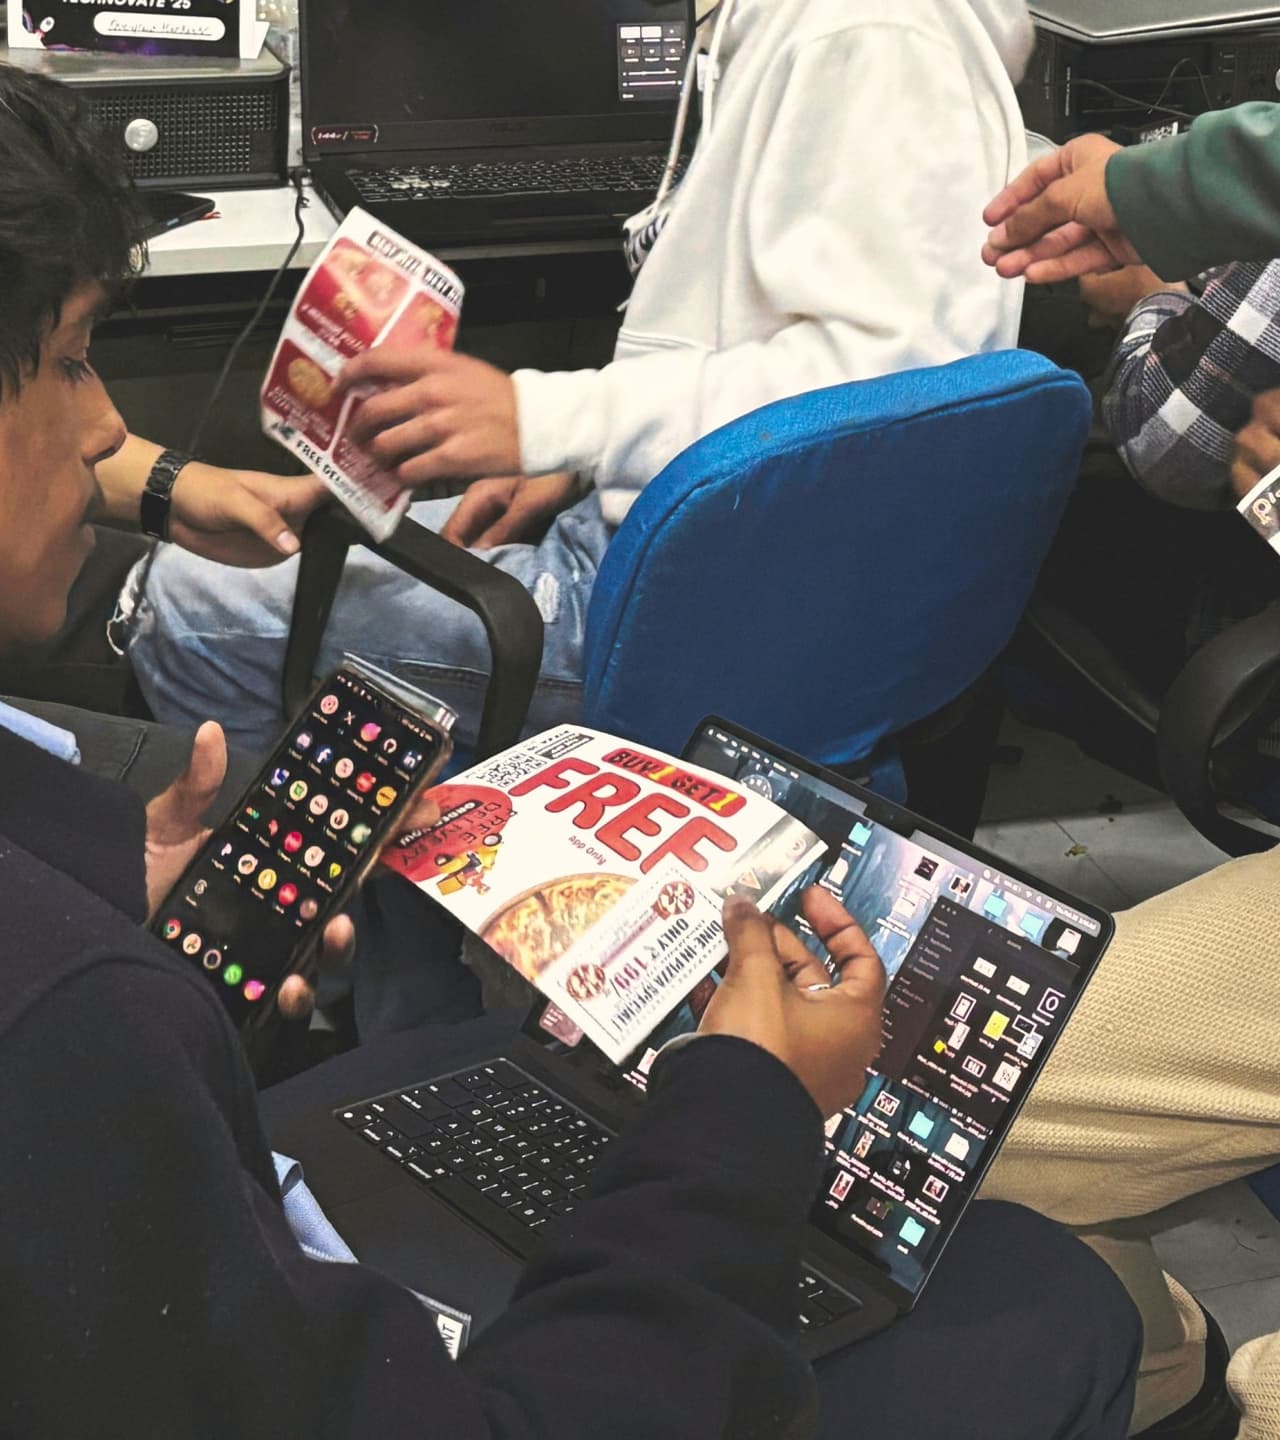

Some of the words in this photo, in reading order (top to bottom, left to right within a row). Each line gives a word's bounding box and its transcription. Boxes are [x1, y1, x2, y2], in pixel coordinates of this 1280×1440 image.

[611, 750, 661, 779] BUY
[671, 774, 719, 804] GET
[709, 792, 739, 811] 1
[507, 756, 738, 875] FREE
[656, 917, 690, 952] ONLY
